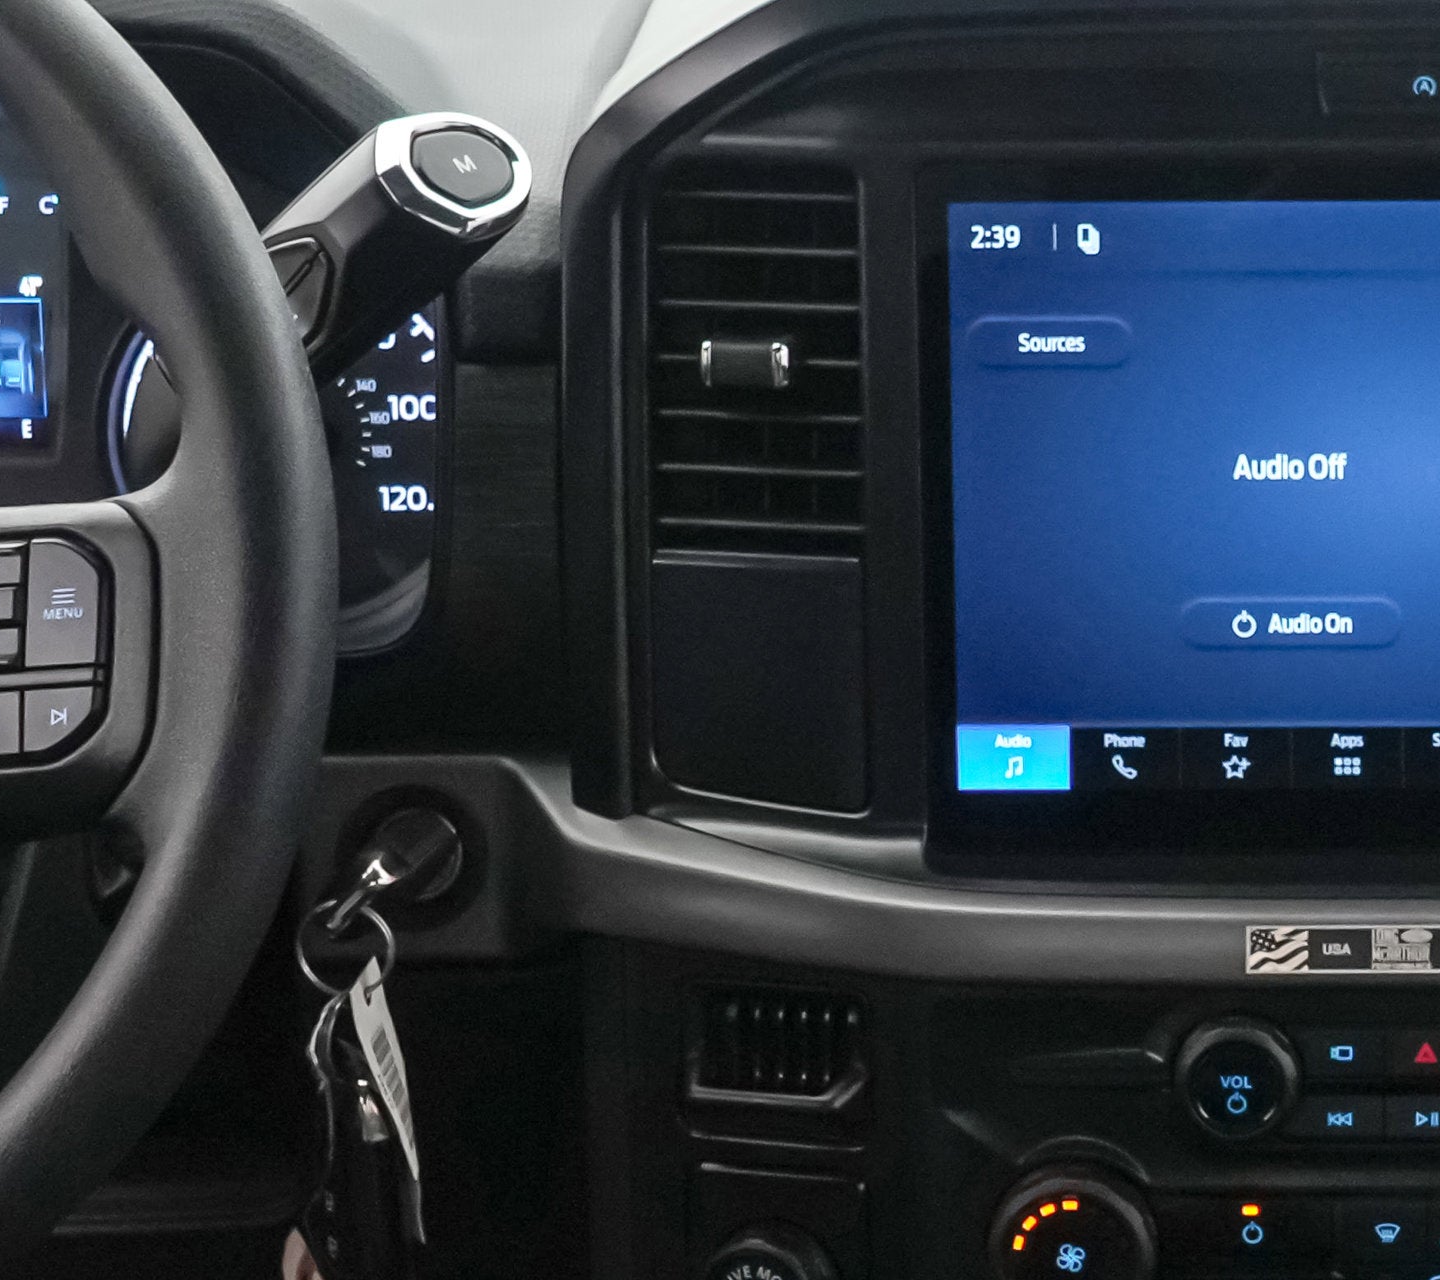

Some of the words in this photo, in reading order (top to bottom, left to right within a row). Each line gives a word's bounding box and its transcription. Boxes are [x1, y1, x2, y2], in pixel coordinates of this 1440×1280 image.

[970, 224, 1021, 250] 2:39
[1017, 333, 1086, 353] Sources
[1232, 453, 1305, 481] Audio
[1308, 451, 1348, 480] Off
[42, 606, 84, 621] MENU
[1268, 613, 1323, 635] Audio
[1324, 612, 1354, 634] On
[994, 732, 1032, 749] Audio
[1103, 732, 1146, 749] Phone
[1224, 732, 1249, 749] Fav
[1330, 732, 1364, 751] Apps
[1322, 942, 1352, 956] USA
[1220, 1075, 1252, 1089] VOL
